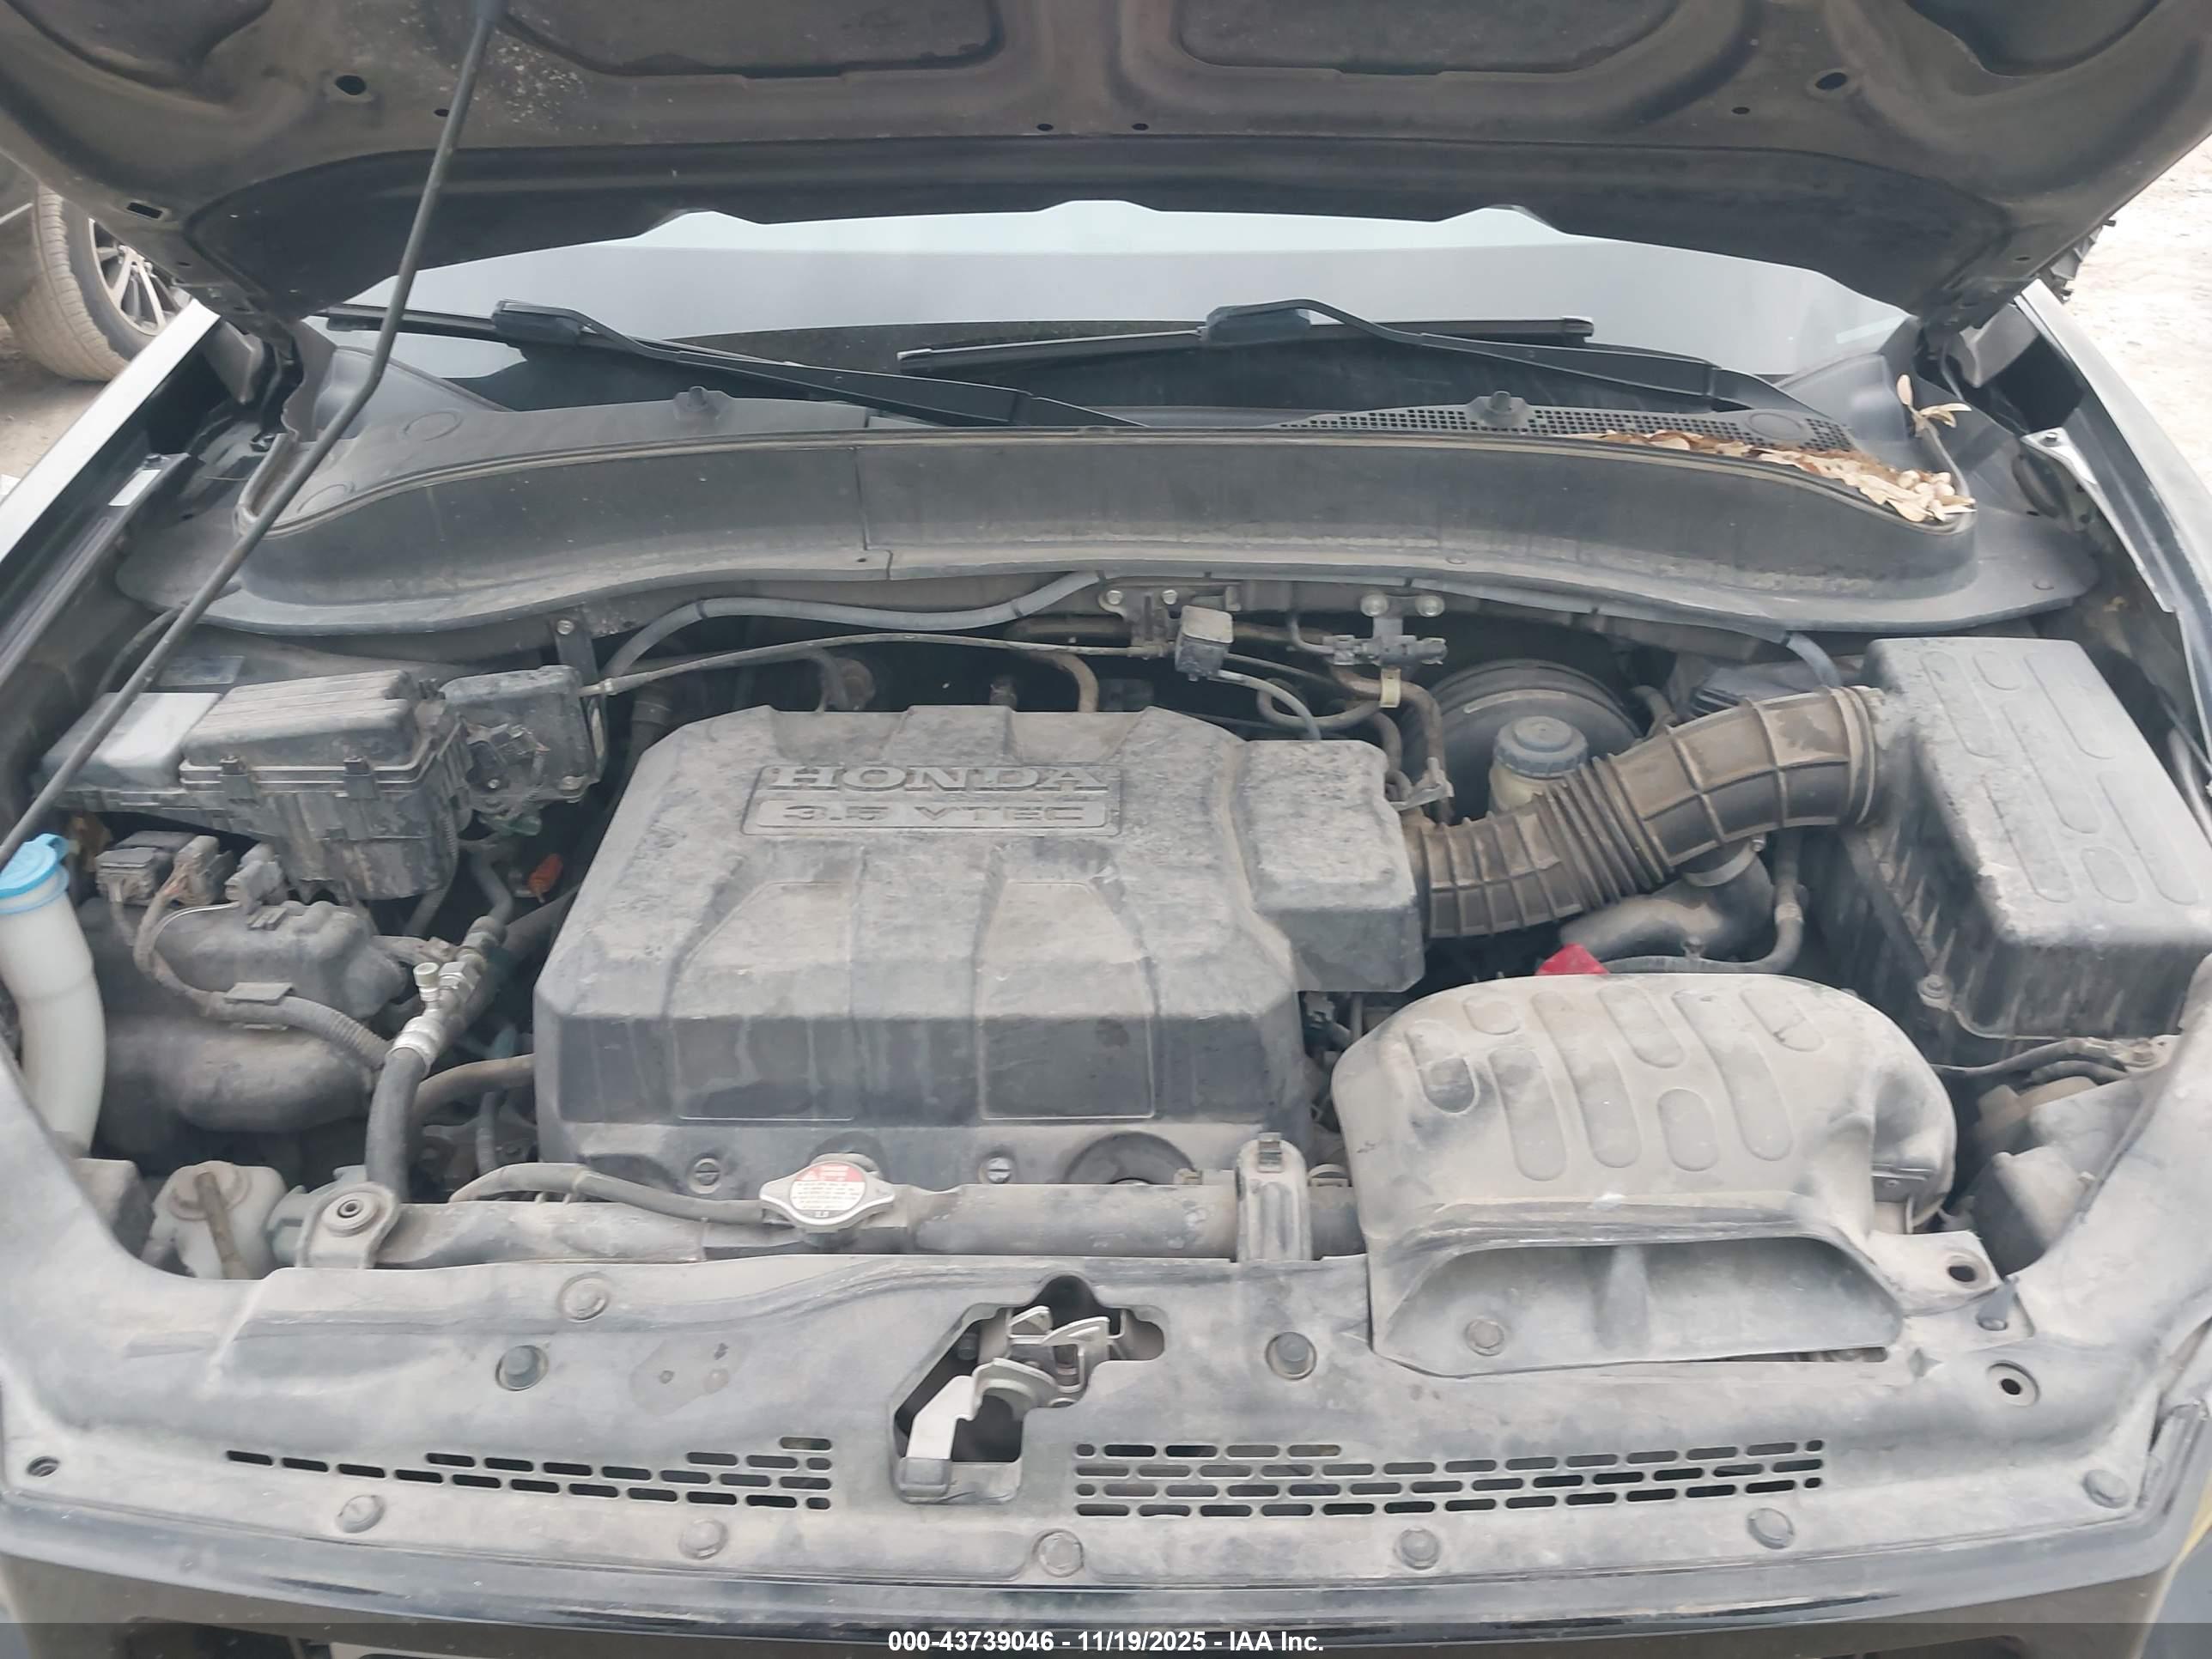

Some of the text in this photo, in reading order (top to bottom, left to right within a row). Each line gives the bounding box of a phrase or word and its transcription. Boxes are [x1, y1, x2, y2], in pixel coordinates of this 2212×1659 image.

[767, 765, 1109, 792] HONDA
[782, 804, 1084, 821] 3.5 VTEC
